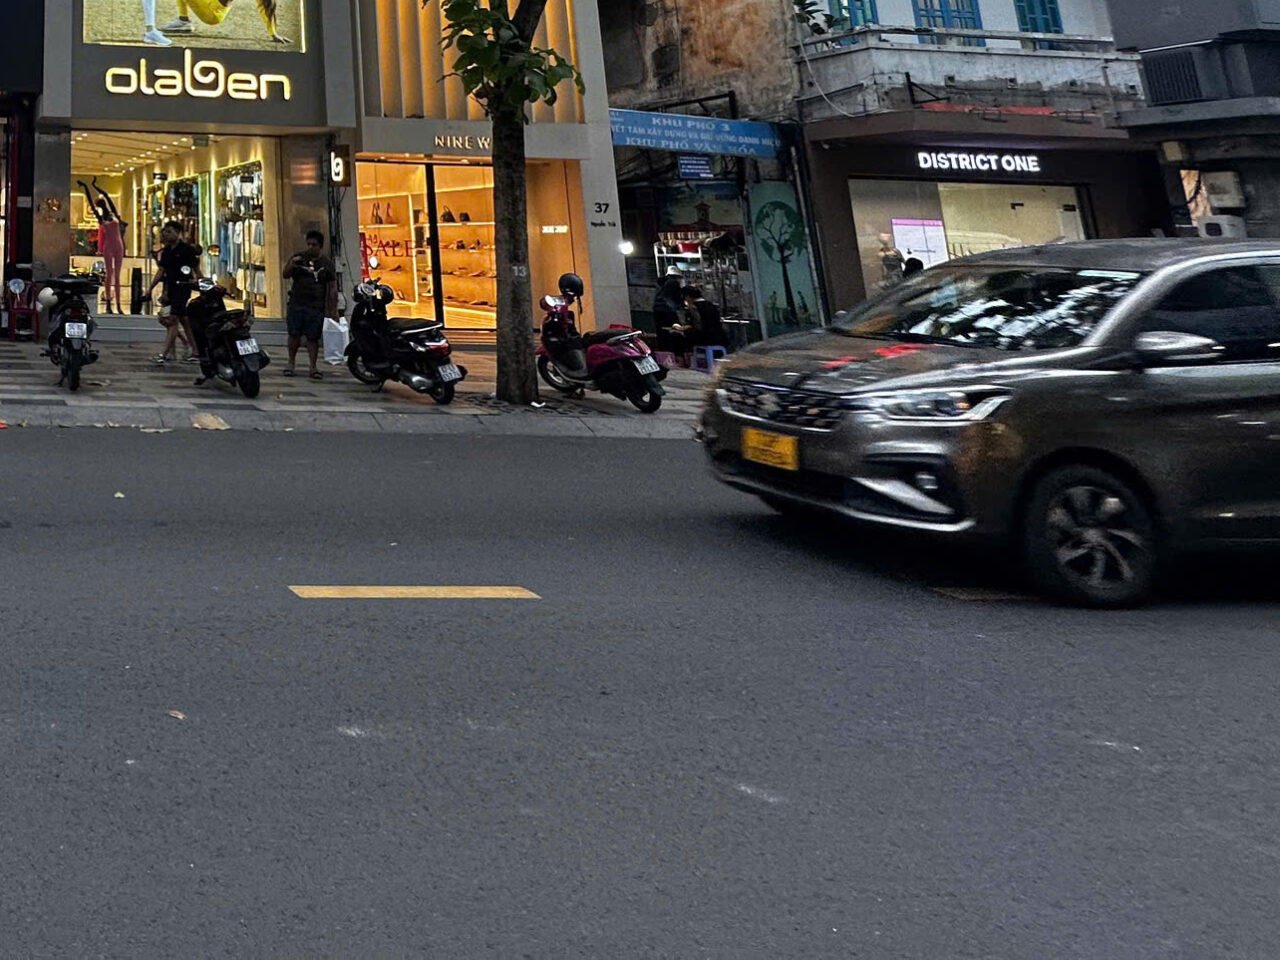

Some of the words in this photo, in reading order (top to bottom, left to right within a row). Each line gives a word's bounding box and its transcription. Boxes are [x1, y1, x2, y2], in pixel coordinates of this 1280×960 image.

[105, 48, 292, 102] olaben
[651, 117, 683, 128] KHU
[720, 123, 730, 132] 3
[435, 135, 473, 149] NINE
[917, 151, 999, 170] DISTRICT
[1001, 154, 1041, 172] ONE
[594, 202, 609, 214] 37
